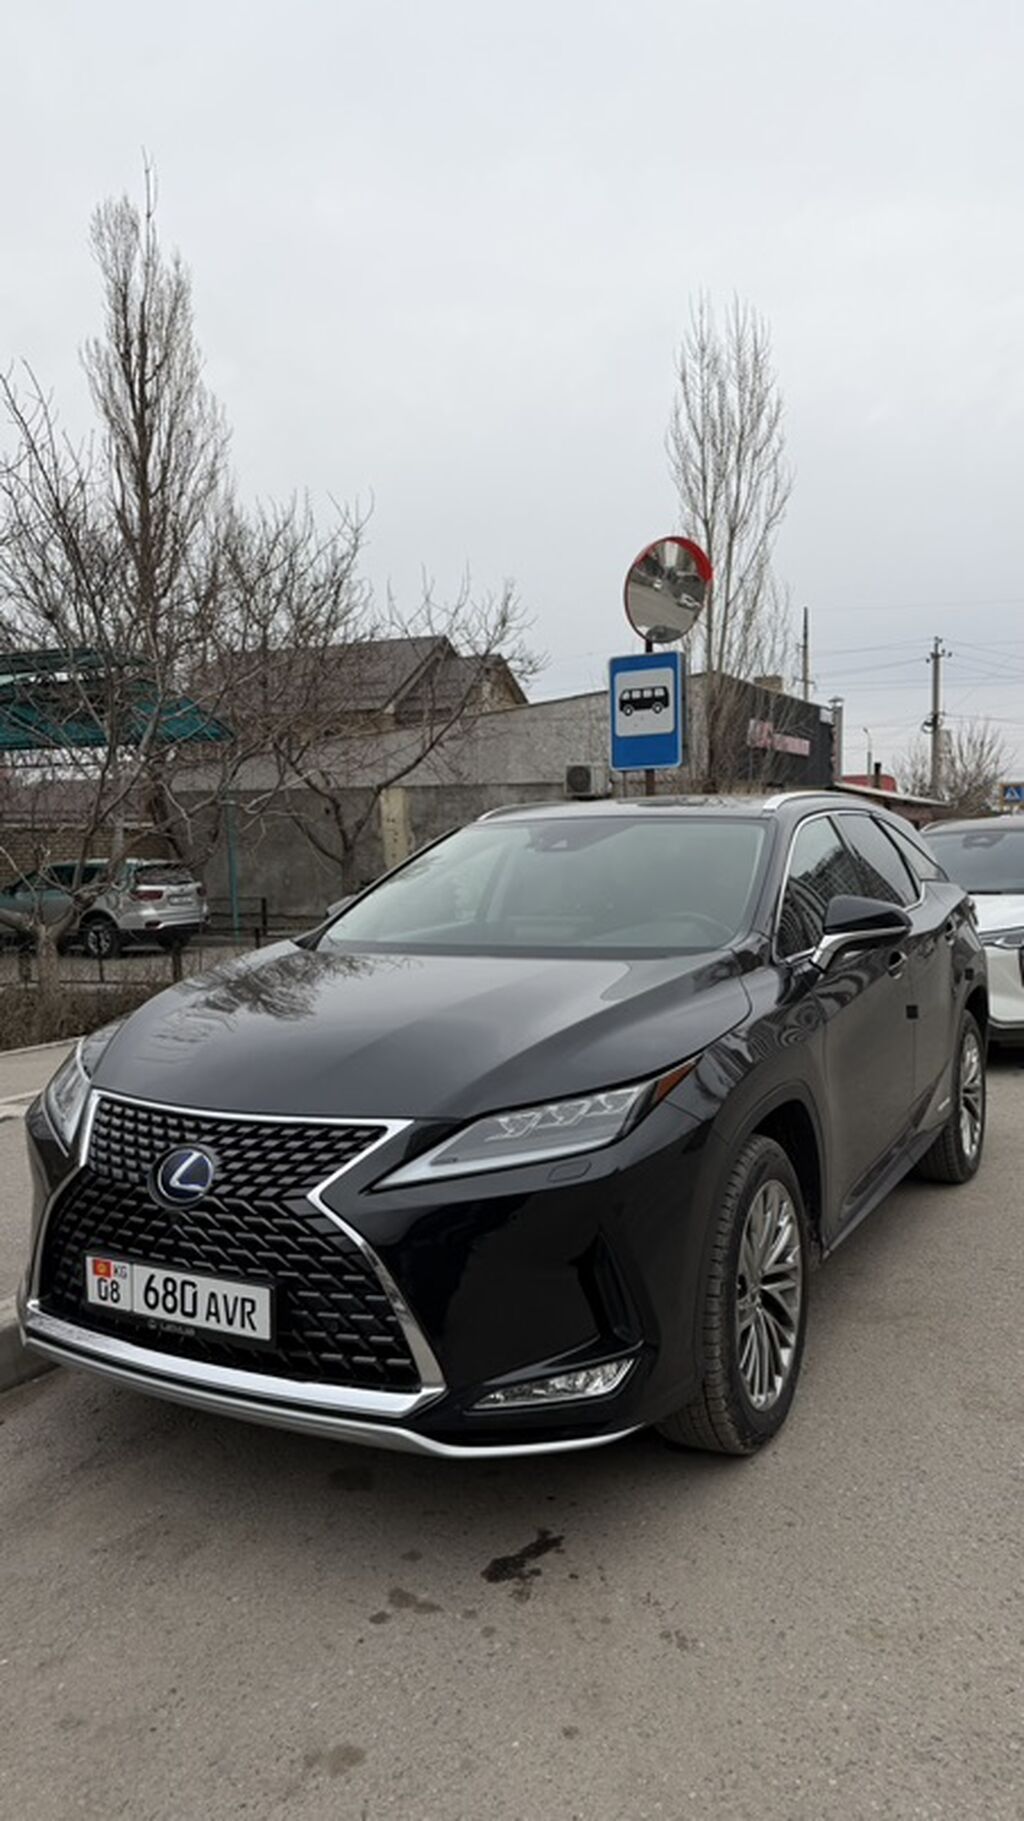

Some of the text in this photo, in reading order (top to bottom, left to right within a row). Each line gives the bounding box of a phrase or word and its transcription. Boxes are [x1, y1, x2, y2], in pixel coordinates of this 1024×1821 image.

[113, 1264, 127, 1280] KG
[97, 1277, 120, 1303] 08
[144, 1274, 198, 1319] 680
[205, 1291, 257, 1331] AVR
